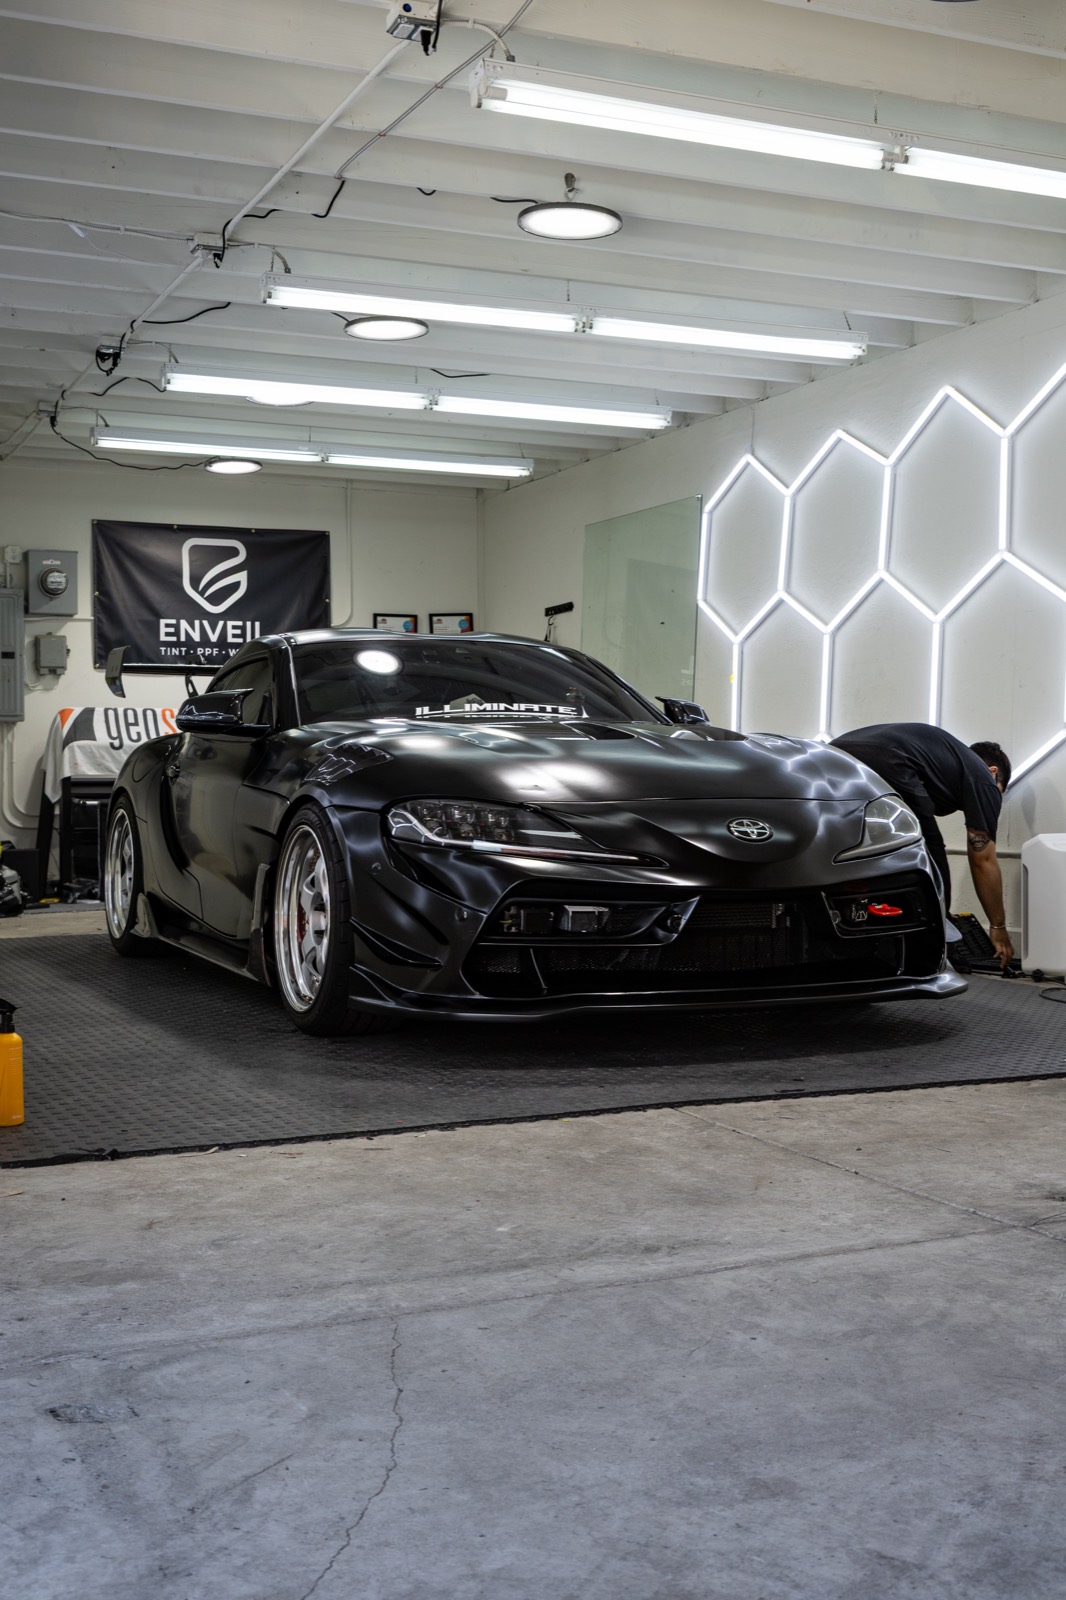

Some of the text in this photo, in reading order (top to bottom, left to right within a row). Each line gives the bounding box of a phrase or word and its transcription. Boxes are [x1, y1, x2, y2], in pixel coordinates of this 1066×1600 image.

[160, 647, 187, 656] TINT
[197, 648, 219, 657] PPF
[104, 707, 178, 751] geos
